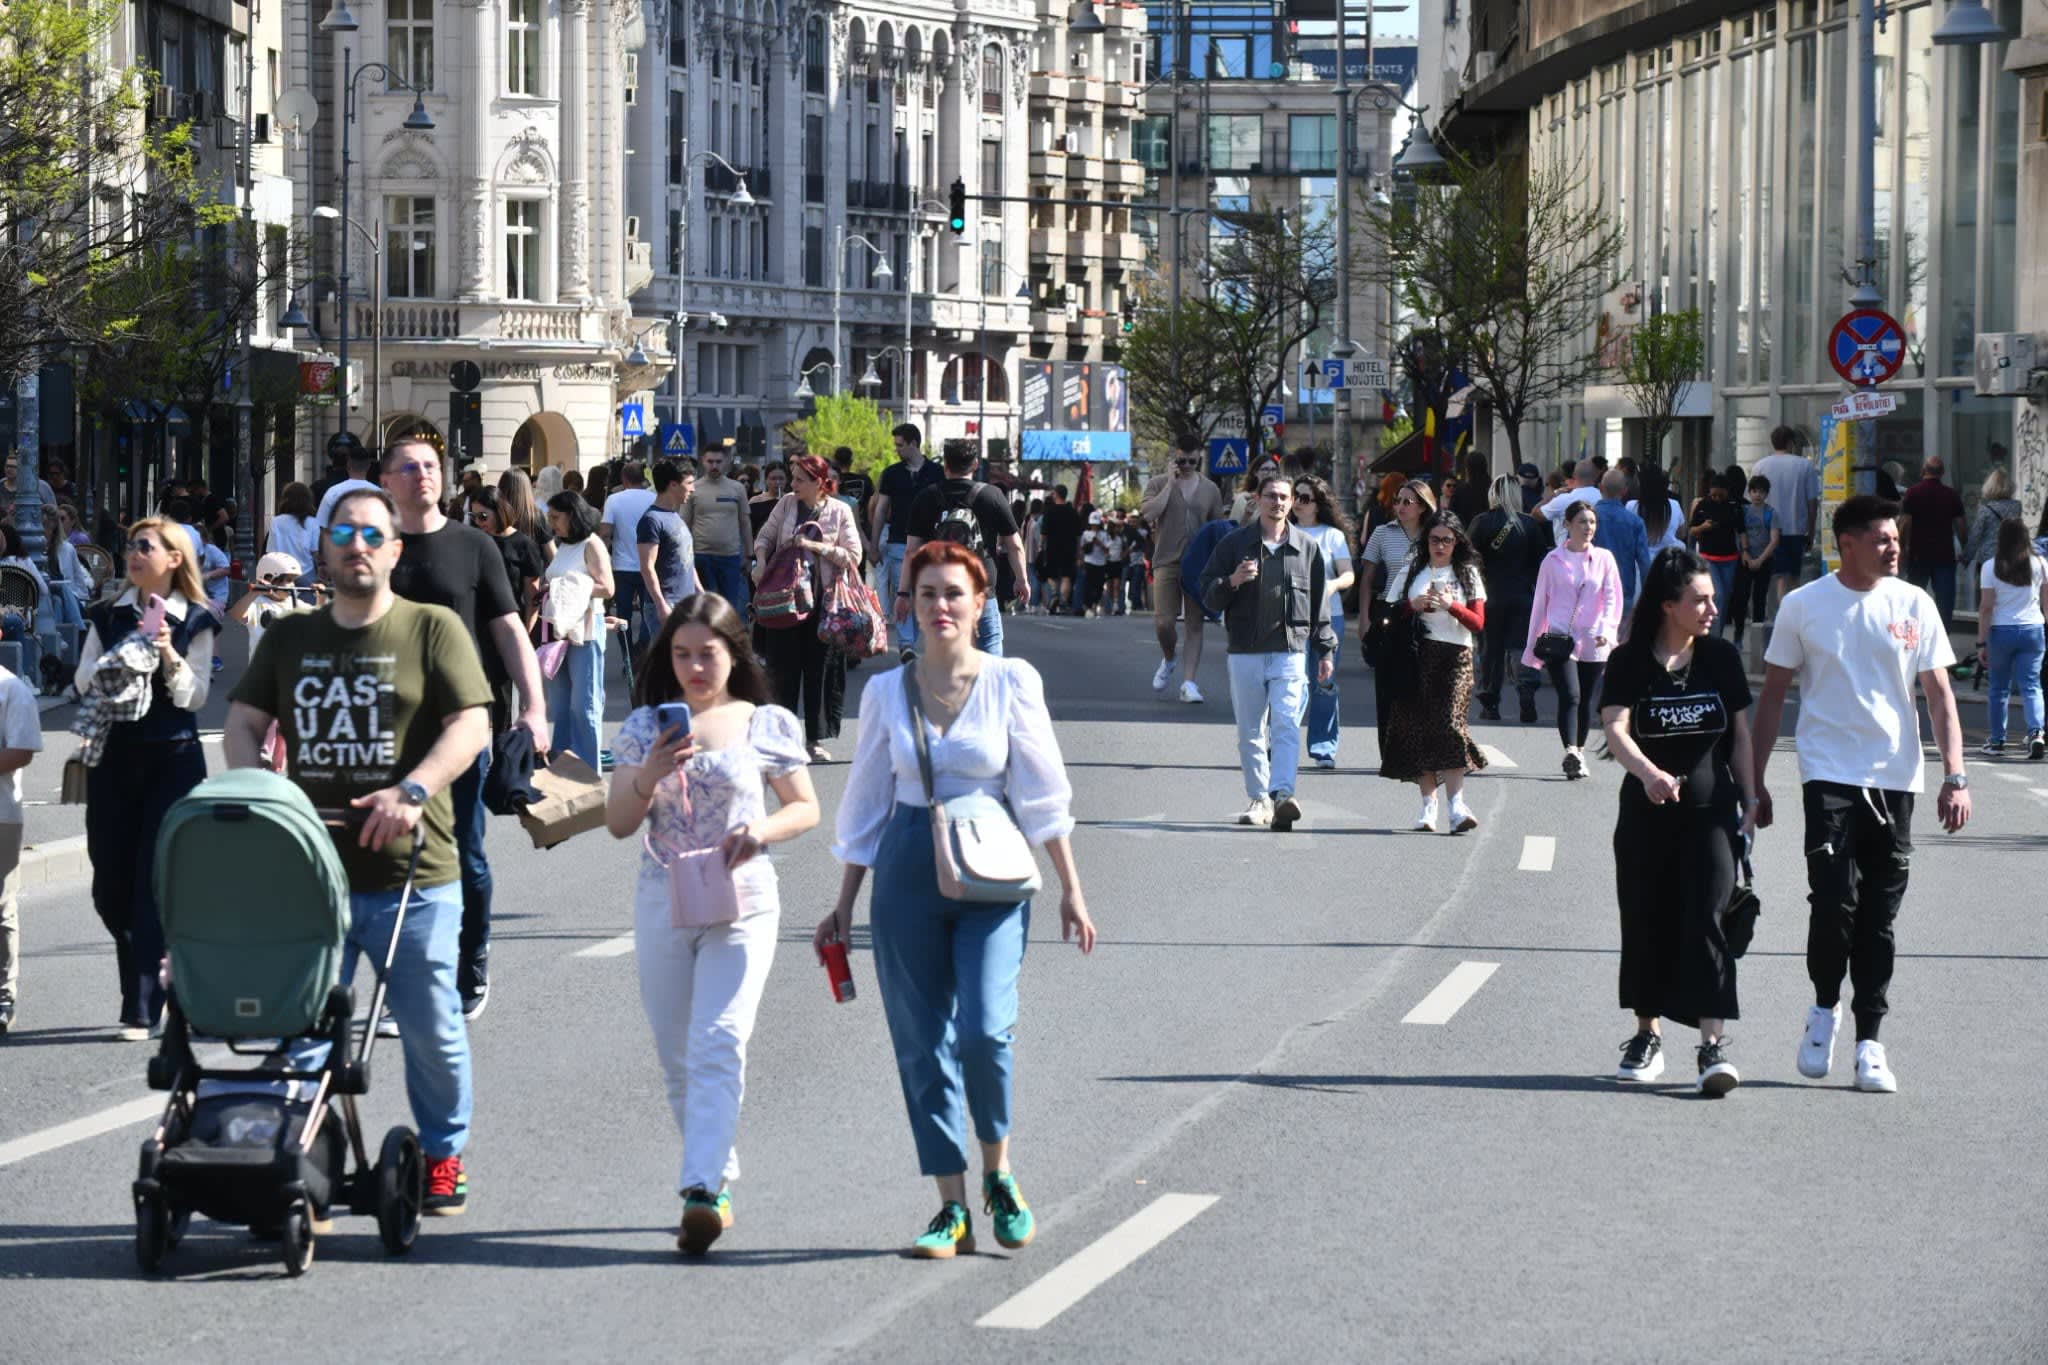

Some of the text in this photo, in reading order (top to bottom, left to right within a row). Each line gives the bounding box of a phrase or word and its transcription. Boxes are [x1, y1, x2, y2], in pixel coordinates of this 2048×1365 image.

[391, 361, 456, 377] GRAN
[482, 361, 542, 379] HOTEL
[1352, 361, 1384, 373] HOTEL
[1345, 375, 1387, 386] NOVOTEL
[1658, 705, 1675, 717] AM
[1676, 703, 1692, 715] MY
[1660, 712, 1704, 727] MUSE
[297, 741, 396, 766] ACTIVE
